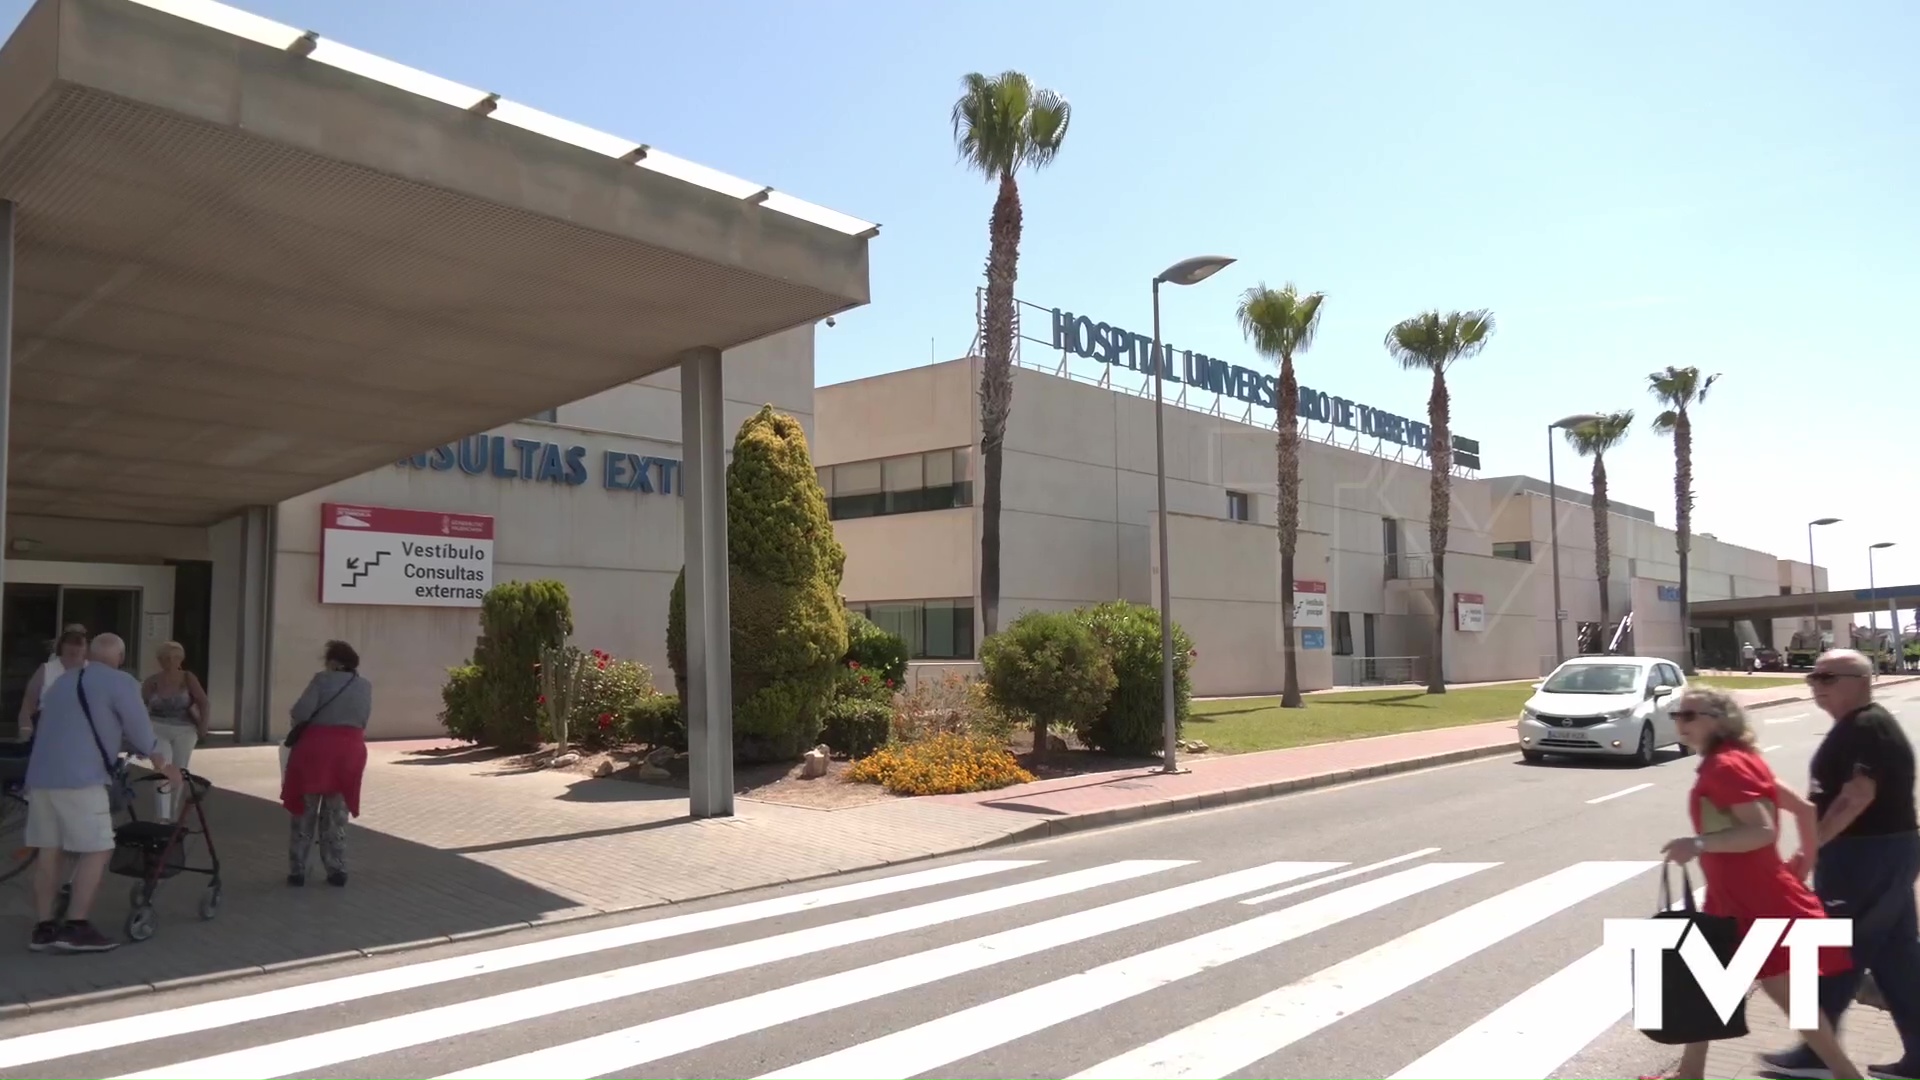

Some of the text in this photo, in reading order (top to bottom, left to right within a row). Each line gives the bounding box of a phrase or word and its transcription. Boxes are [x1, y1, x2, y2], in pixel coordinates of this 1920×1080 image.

[1052, 307, 1433, 457] HOSPITAL UNIVERSRIO DE TORREVIE
[604, 449, 684, 496] EXT
[402, 541, 485, 561] Vestíbulo
[404, 563, 484, 582] Consultas
[415, 584, 484, 600] externas
